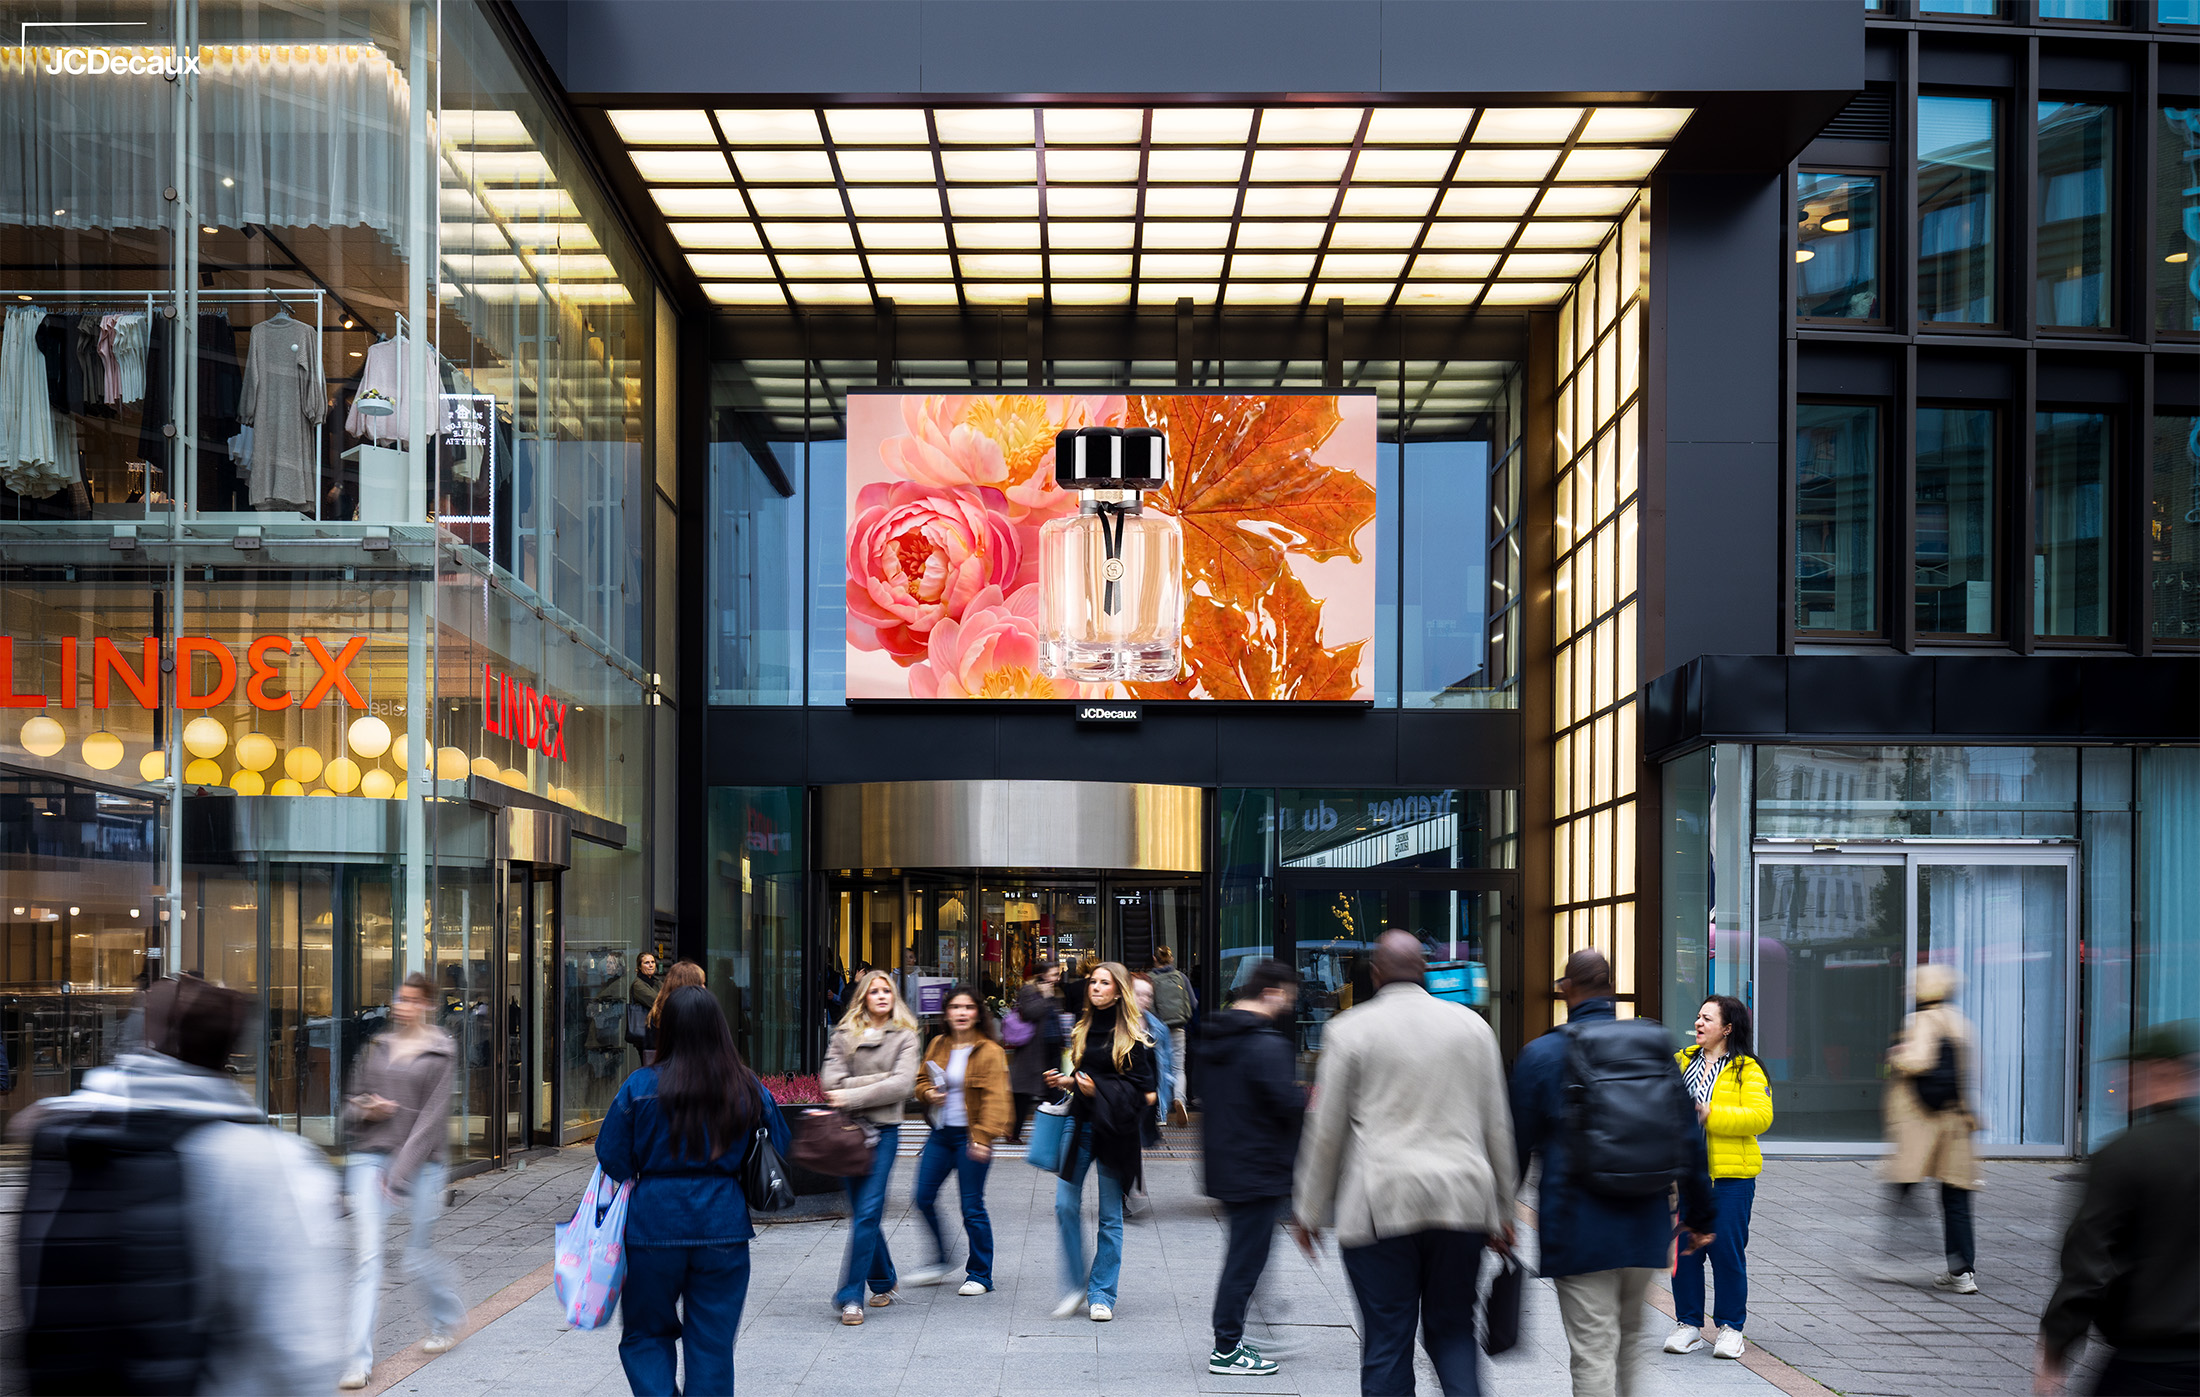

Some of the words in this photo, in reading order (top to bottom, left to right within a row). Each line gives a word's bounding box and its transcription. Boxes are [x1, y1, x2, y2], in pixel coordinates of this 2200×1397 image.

[0, 635, 370, 711] LINDEX
[484, 663, 567, 763] LINDEX
[1080, 708, 1137, 719] JCDecaux
